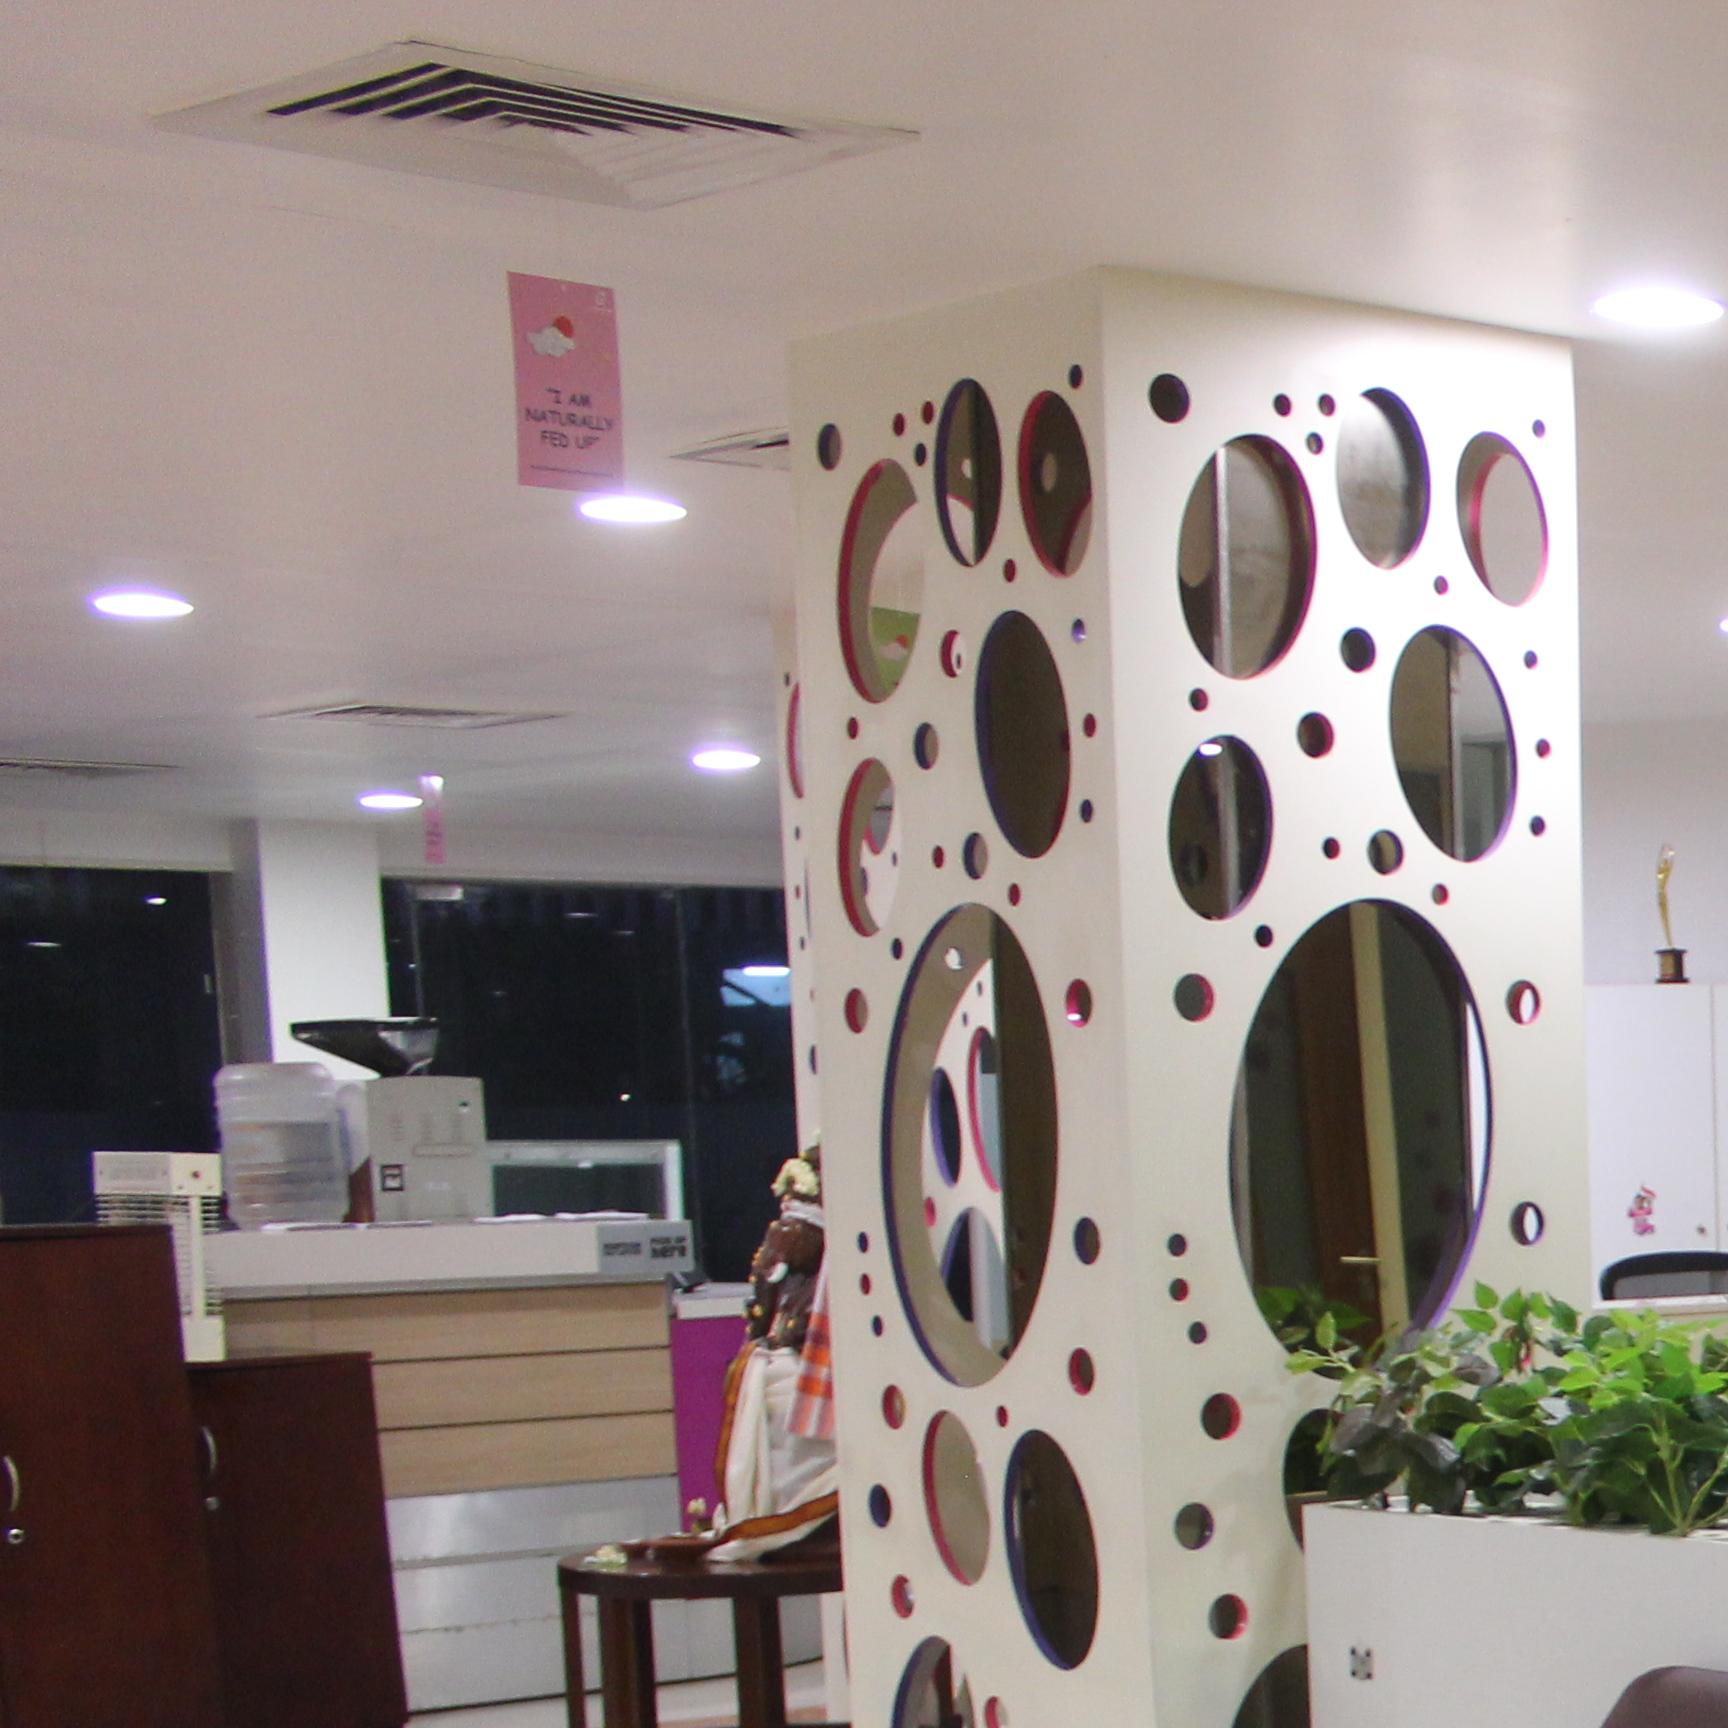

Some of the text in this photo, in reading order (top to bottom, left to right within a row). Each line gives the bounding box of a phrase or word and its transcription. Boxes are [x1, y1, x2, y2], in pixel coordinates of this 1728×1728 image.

[569, 394, 592, 407] AM
[525, 408, 613, 431] NATURALLY
[541, 430, 569, 448] FED
